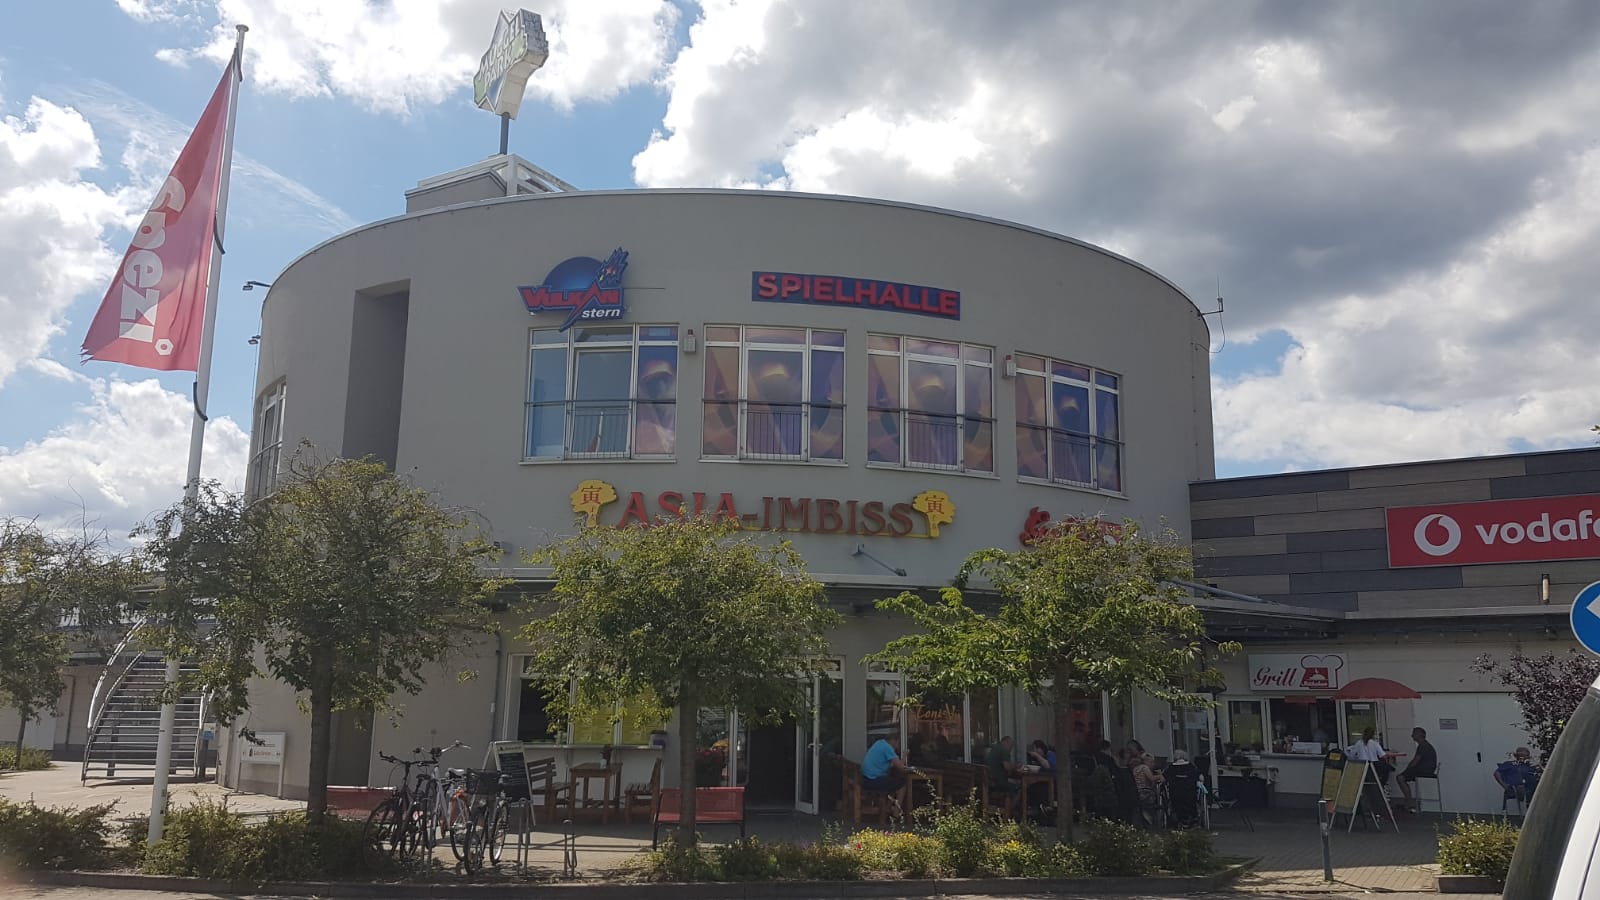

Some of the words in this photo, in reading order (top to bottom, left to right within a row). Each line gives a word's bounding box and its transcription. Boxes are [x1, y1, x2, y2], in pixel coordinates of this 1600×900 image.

[758, 273, 959, 315] SPIELHALLE
[582, 307, 620, 319] stern
[1474, 509, 1600, 545] vodaf
[1253, 667, 1298, 686] Grill
